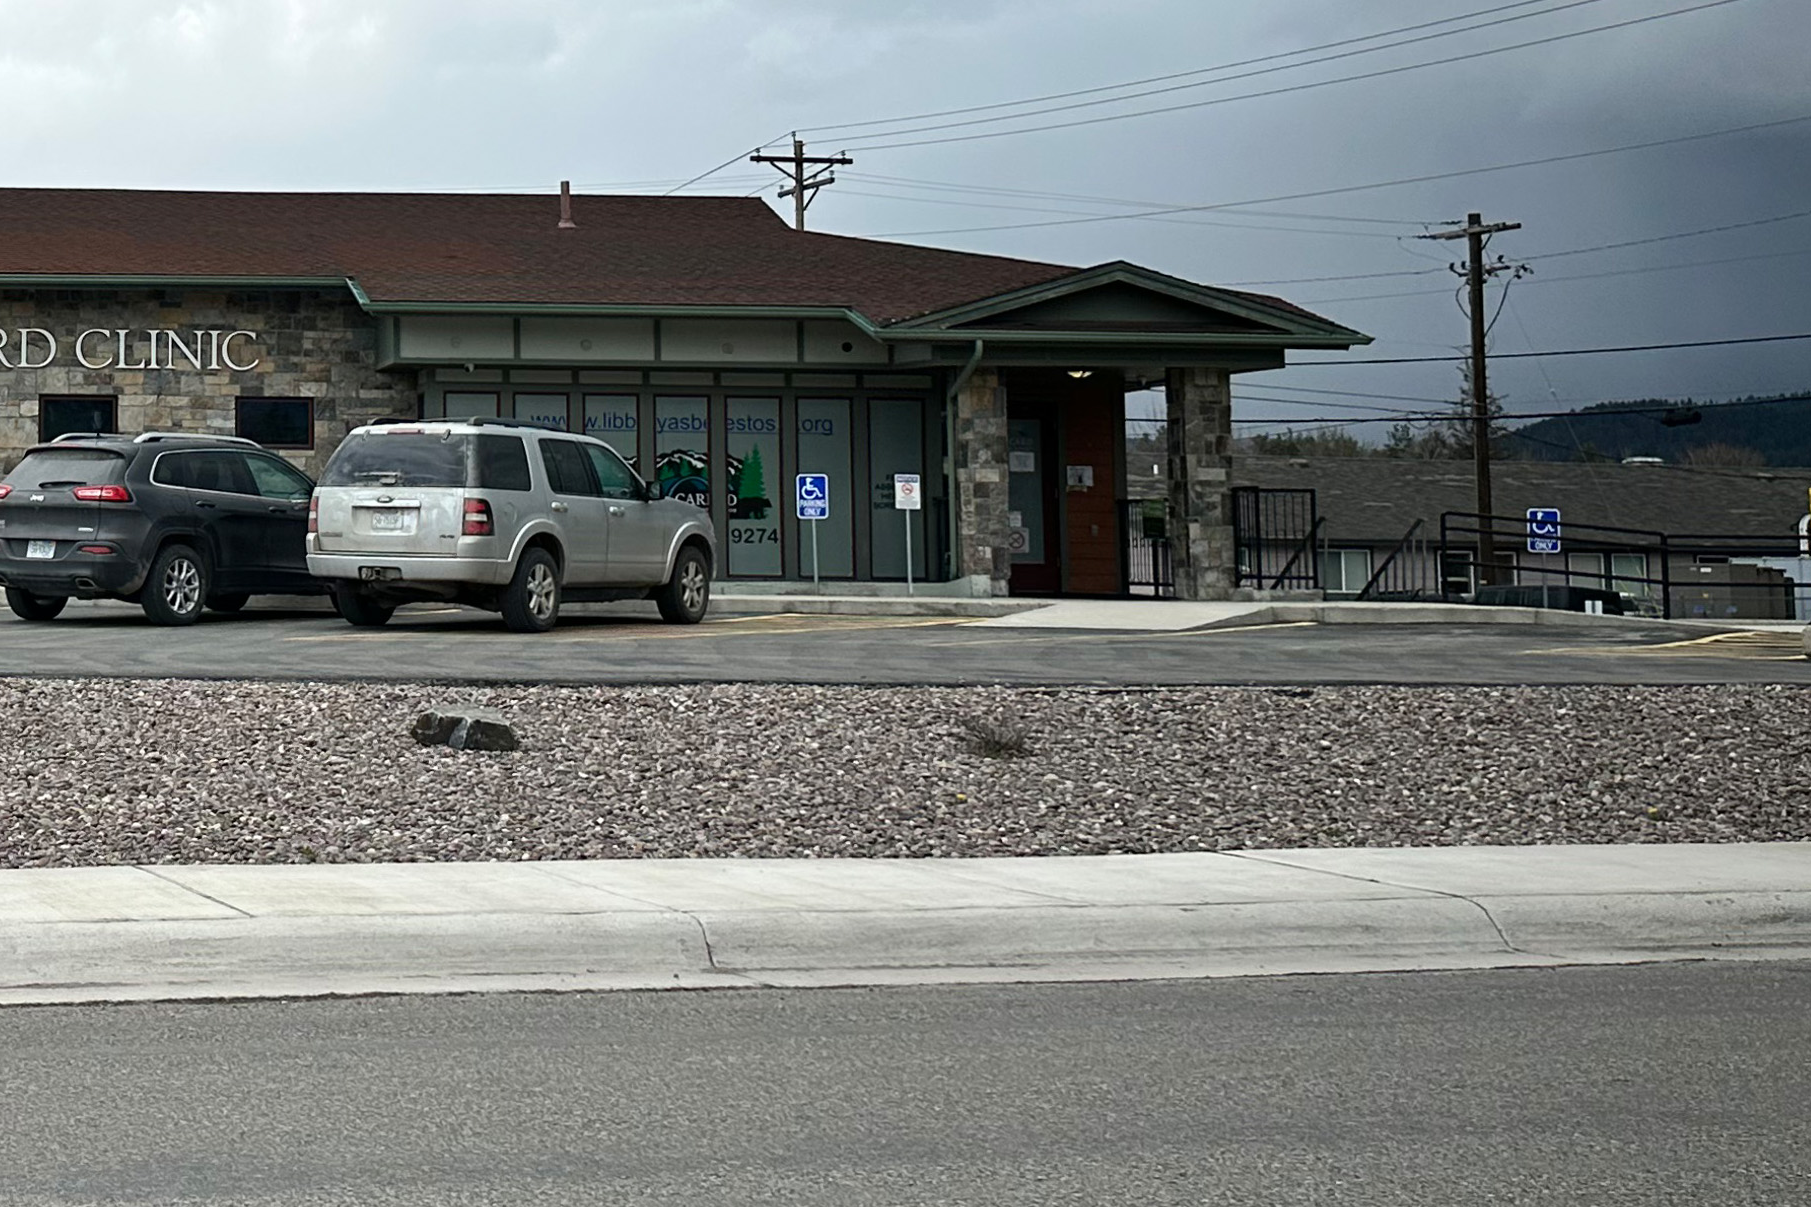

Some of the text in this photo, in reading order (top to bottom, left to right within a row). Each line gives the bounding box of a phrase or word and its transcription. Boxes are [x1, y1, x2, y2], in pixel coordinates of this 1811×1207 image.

[75, 328, 260, 372] CLINIC
[803, 507, 822, 516] ONLY
[731, 528, 779, 544] 9274
[1534, 541, 1553, 551] ONLY
